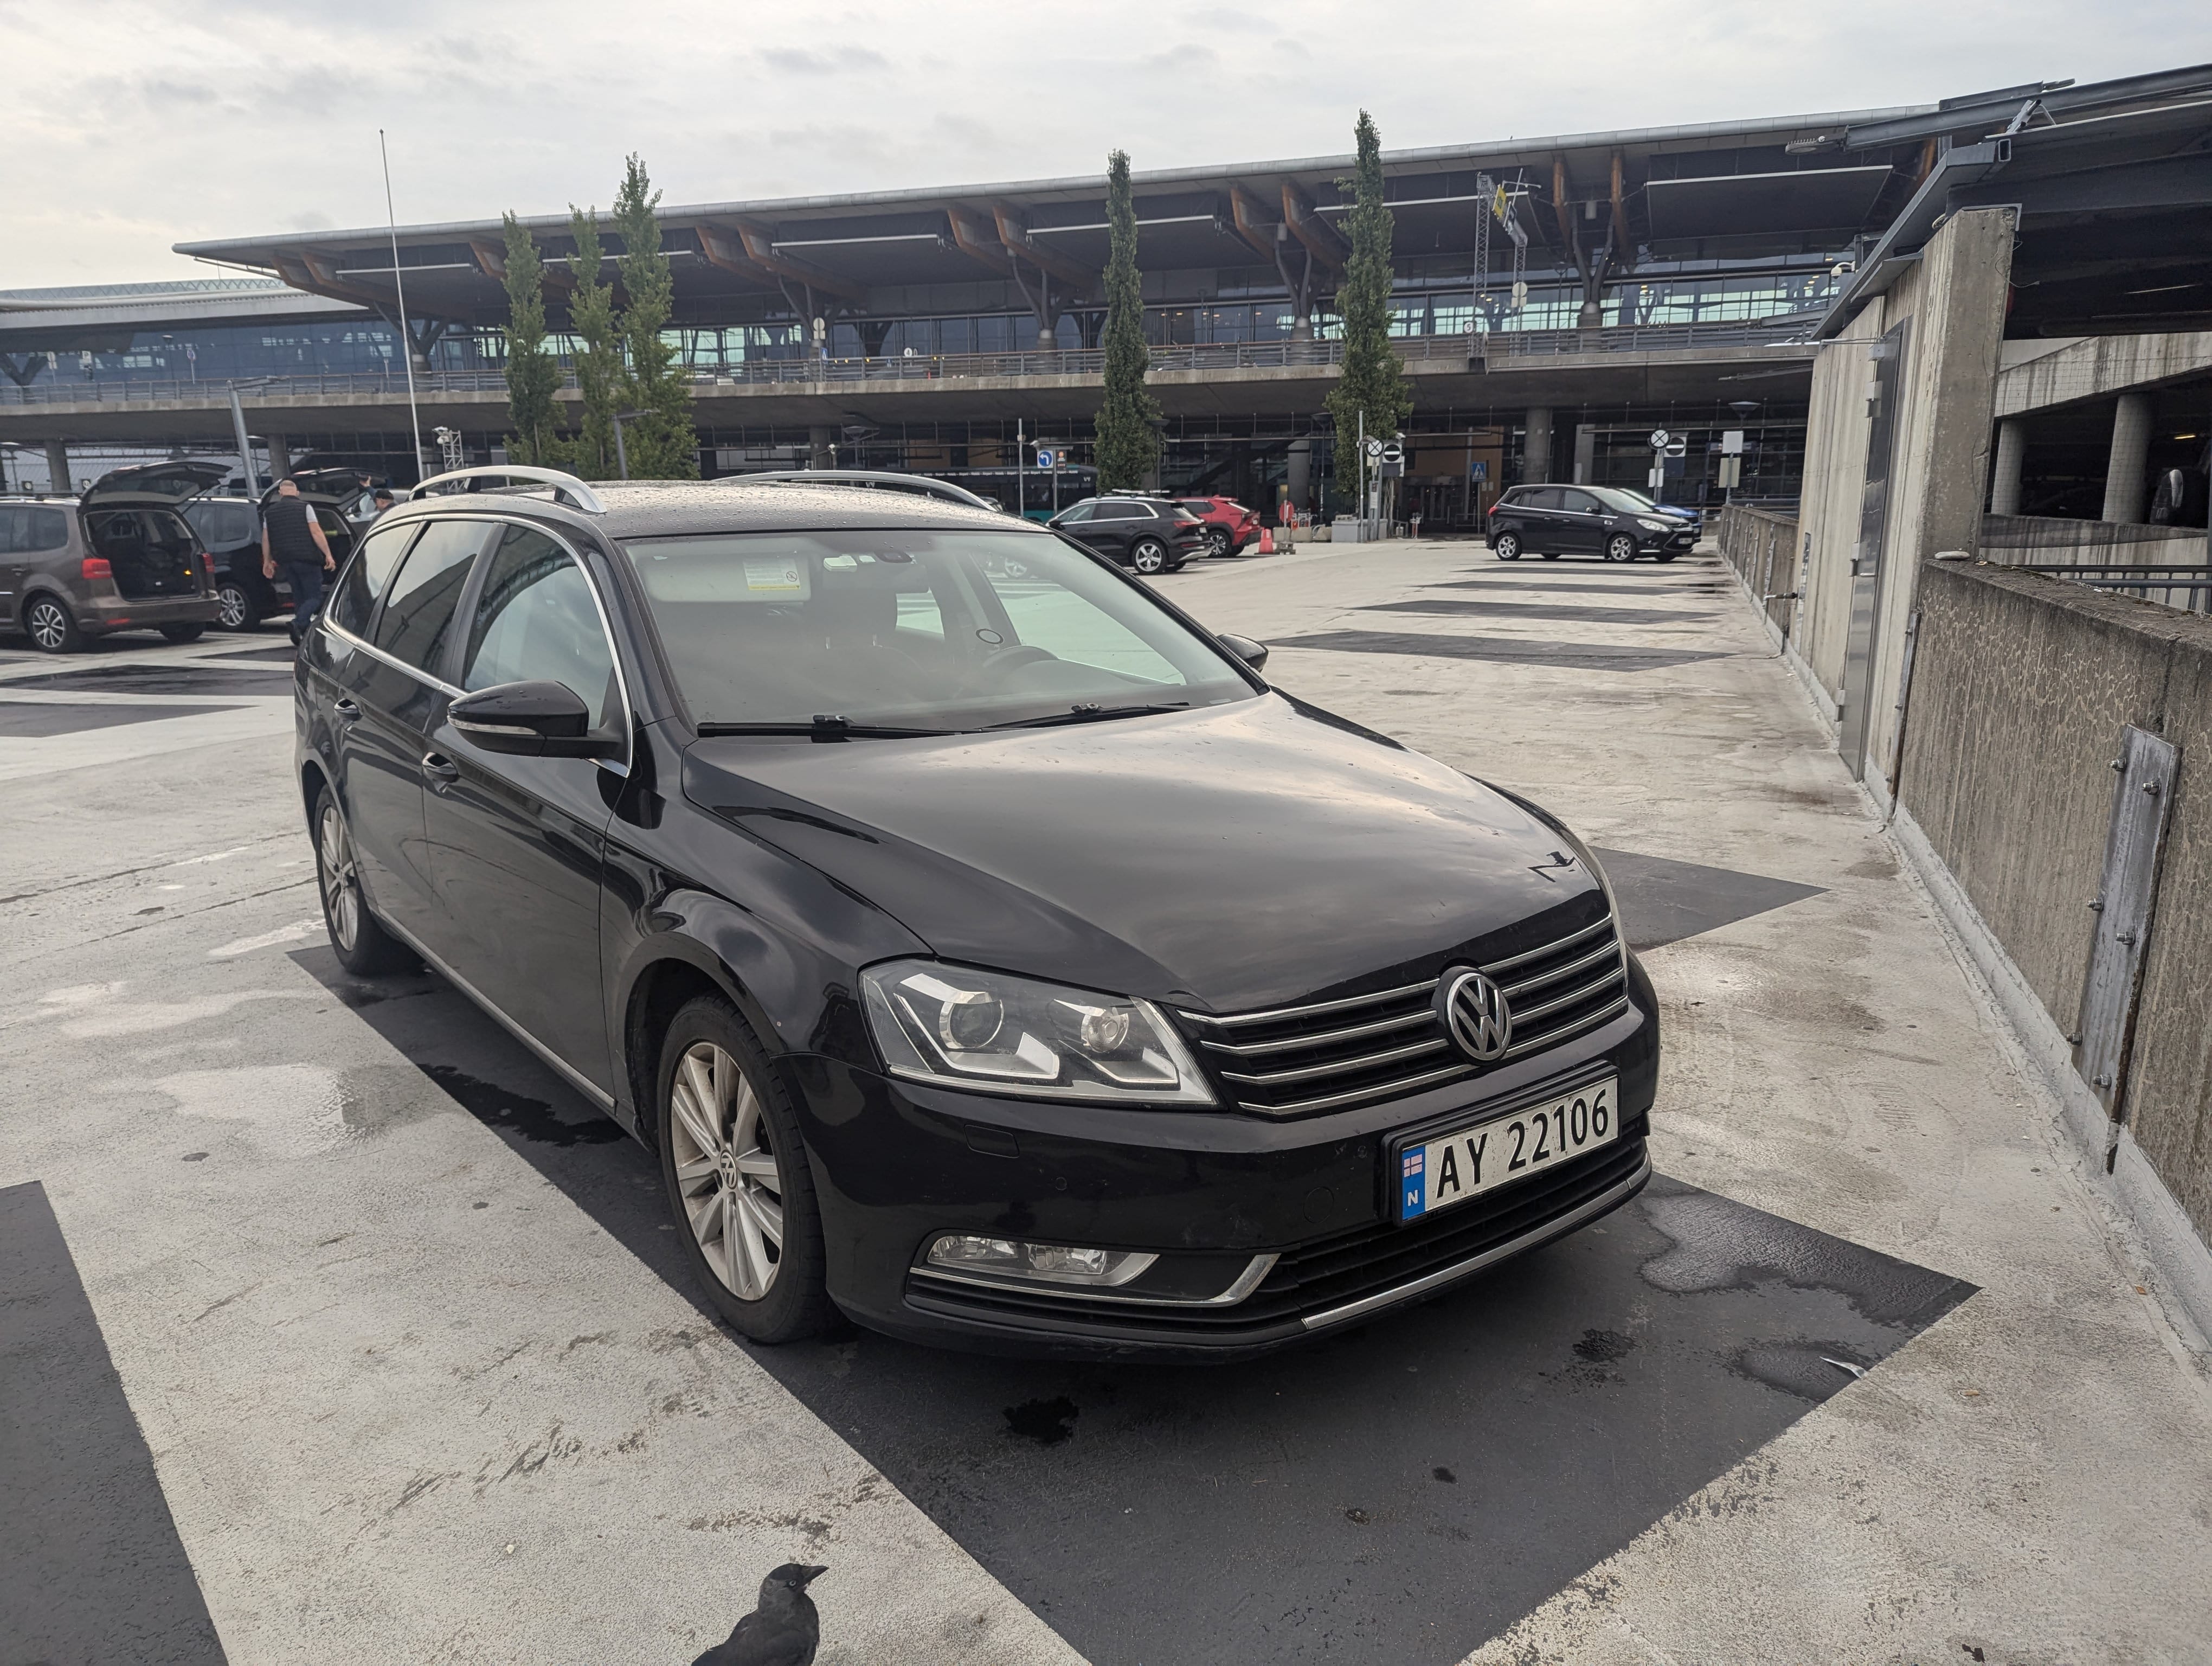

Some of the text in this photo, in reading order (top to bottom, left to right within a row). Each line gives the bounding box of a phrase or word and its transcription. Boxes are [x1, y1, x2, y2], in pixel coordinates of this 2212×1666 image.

[1450, 976, 1509, 1056] VW
[1436, 1088, 1609, 1199] AY 22106
[1407, 1189, 1419, 1207] N
